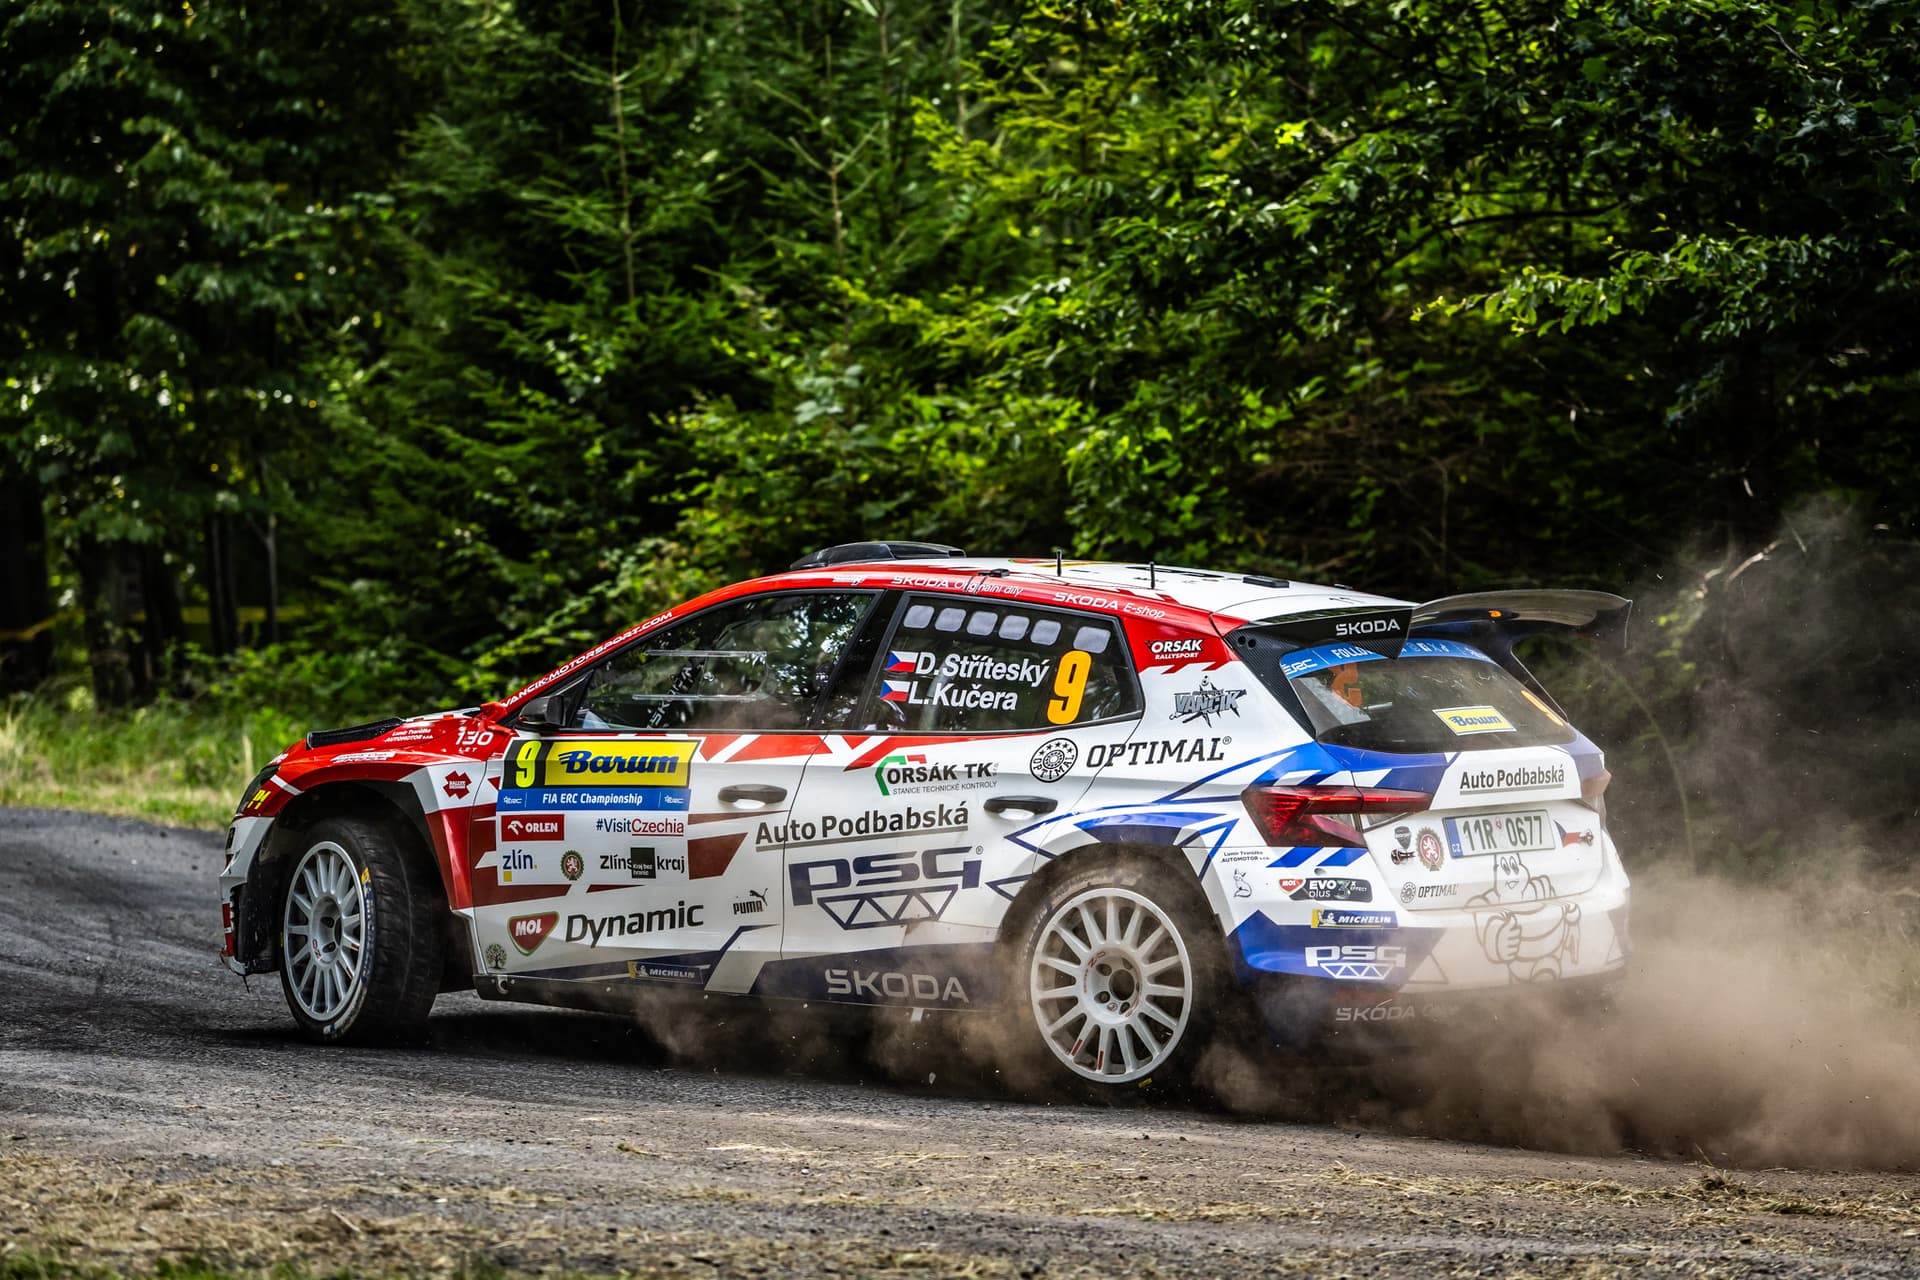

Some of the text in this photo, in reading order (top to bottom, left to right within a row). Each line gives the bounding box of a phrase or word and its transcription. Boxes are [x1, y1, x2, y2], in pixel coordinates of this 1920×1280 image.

[1123, 603, 1166, 619] E-shop
[1151, 639, 1203, 653] ORSÁK
[1155, 652, 1199, 660] RALLYSPORT
[942, 653, 1051, 688] Stříteský
[1047, 650, 1092, 725] 9
[932, 683, 1018, 711] Kučera
[1449, 715, 1502, 726] Barum
[456, 730, 493, 746] 130
[516, 740, 679, 788] 9 Barum
[887, 762, 958, 784] ORSÁK
[964, 762, 993, 779] TK
[1460, 764, 1564, 789] Auto Podbabská
[893, 780, 998, 795] STANICE TECHNICKÉ KONTROLY
[542, 792, 643, 806] FIA ERC Championship
[525, 822, 558, 833] ORLEN
[596, 817, 684, 834] #VisitCzechia
[756, 801, 968, 845] Auto Podbabská
[1463, 815, 1543, 851] 11R 0677
[657, 855, 685, 874] kraj
[1309, 880, 1337, 890] EVO
[1418, 884, 1456, 898] OPTIMAL
[733, 901, 764, 915] PUMA
[515, 901, 704, 949] MOL Dynamic
[1338, 915, 1391, 923] MICHELIN
[650, 968, 695, 979] MICHELIN
